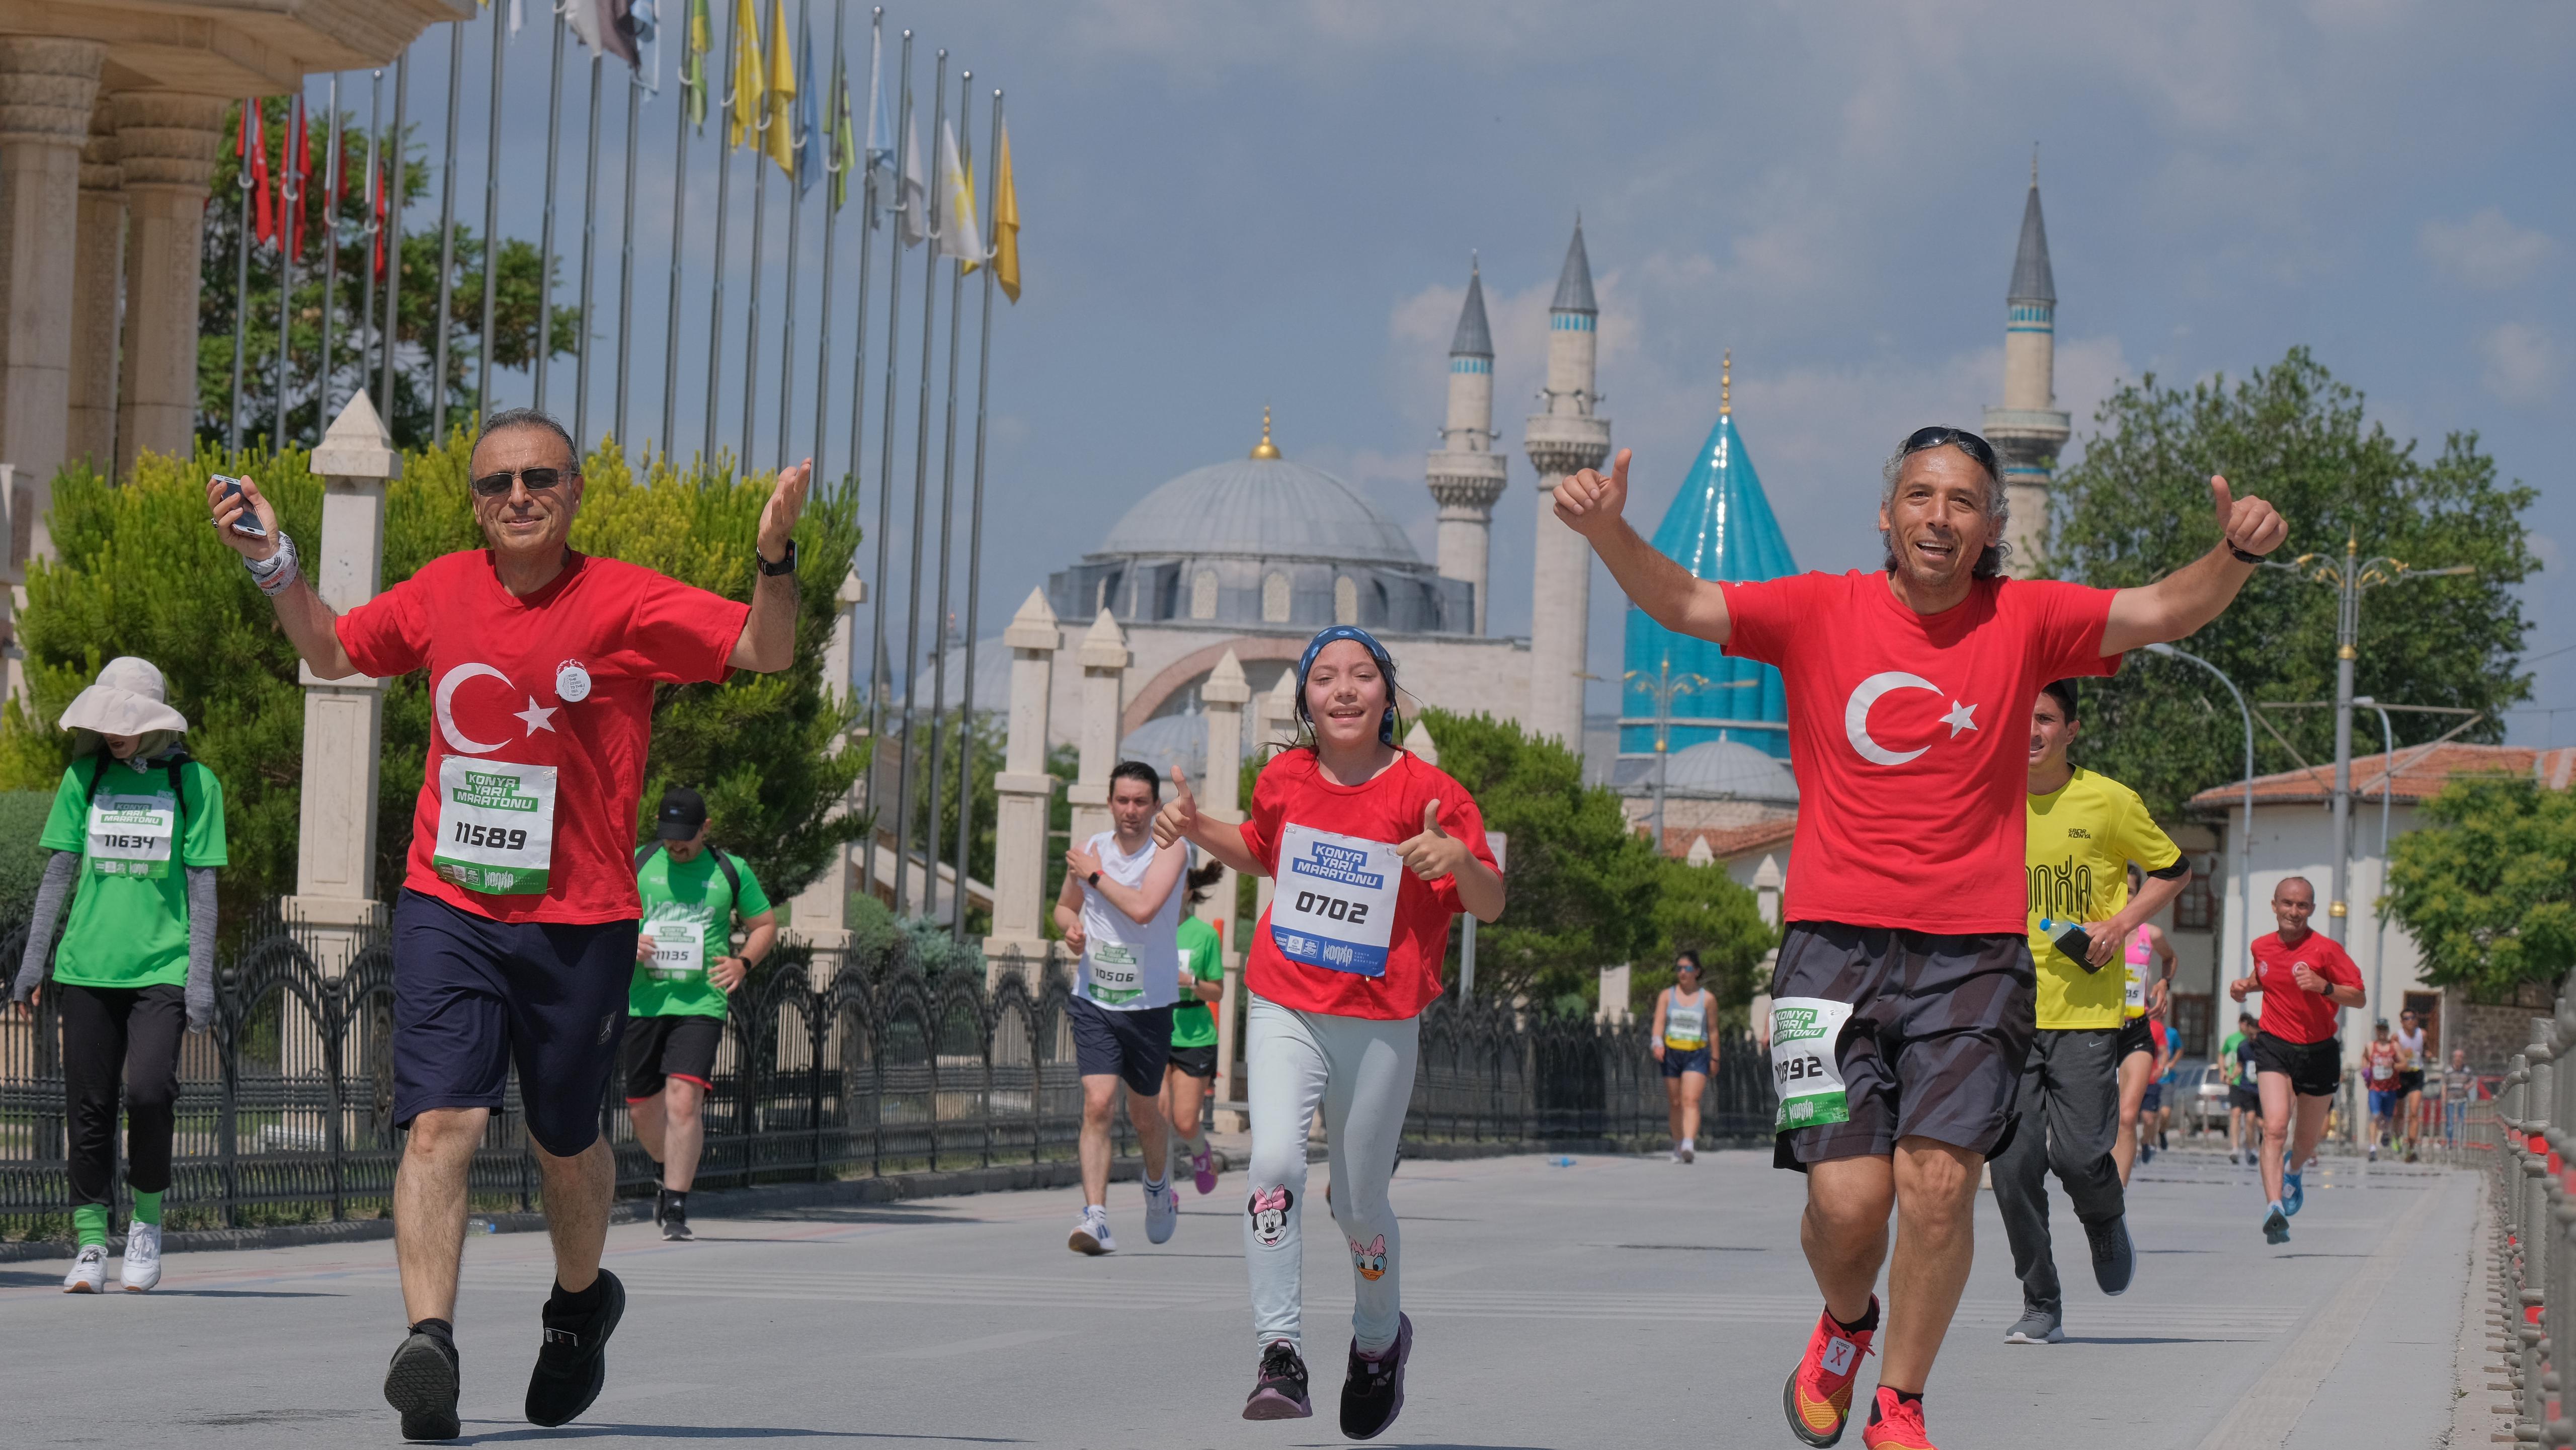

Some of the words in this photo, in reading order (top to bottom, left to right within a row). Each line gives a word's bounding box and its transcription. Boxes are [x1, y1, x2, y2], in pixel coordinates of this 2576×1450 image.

[469, 773, 516, 787] KONYA
[475, 785, 507, 796] YARI
[457, 791, 532, 810] MARATONU
[104, 816, 159, 825] MARATONU
[105, 834, 155, 849] 11634
[455, 821, 527, 850] 11589
[1315, 845, 1363, 863] KONYA
[1323, 856, 1354, 871] YARI
[1297, 861, 1378, 886] MARATONU
[1296, 891, 1369, 924] 0702
[656, 950, 689, 960] 11135
[1095, 968, 1134, 982] 10506
[1776, 1010, 1813, 1021] KONYA
[1779, 1020, 1804, 1030] YARI
[1836, 1340, 1850, 1349] 10992
